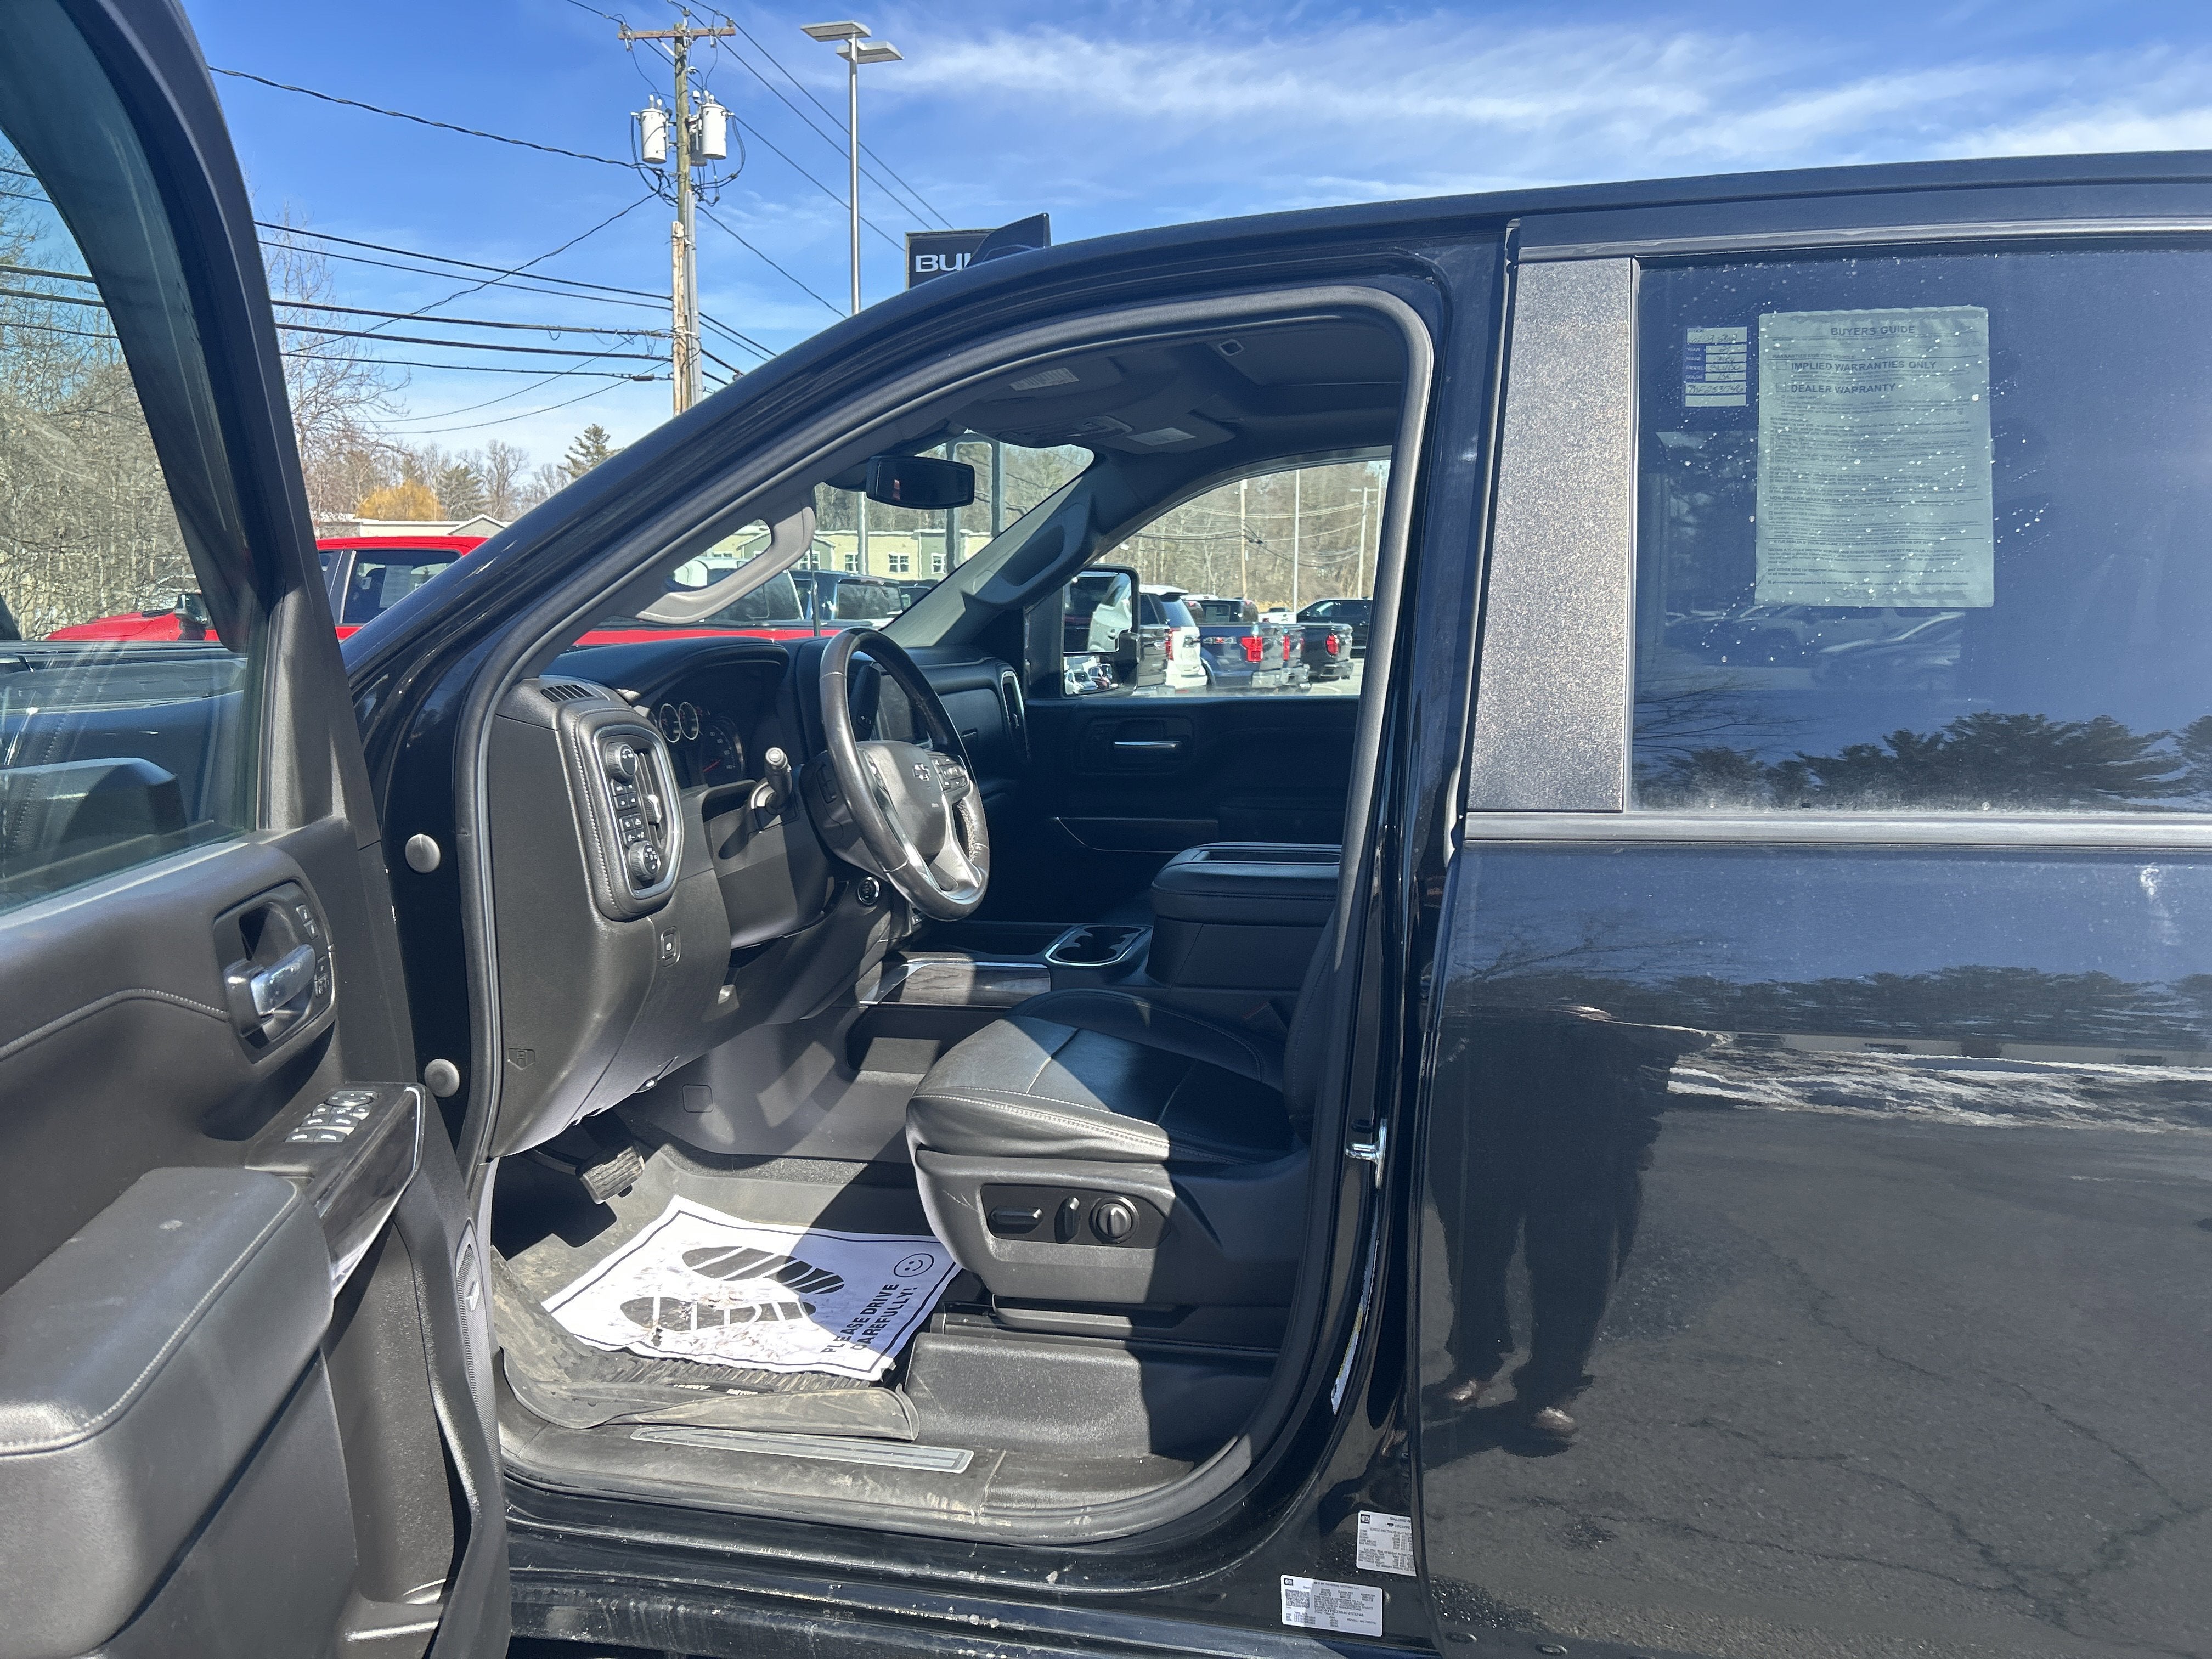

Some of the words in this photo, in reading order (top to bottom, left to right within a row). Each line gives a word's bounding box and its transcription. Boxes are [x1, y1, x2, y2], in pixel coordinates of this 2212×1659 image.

[1831, 327, 1875, 336] BUYERS
[1880, 325, 1915, 335] GUIDE
[1791, 362, 1832, 370] IMPLIED
[1835, 360, 1905, 371] WARRANTIES
[1909, 360, 1937, 369] ONLY
[1791, 385, 1832, 393] DEALER
[1835, 383, 1895, 394] WARRANTY
[820, 1317, 871, 1353] PLEASE
[860, 1284, 900, 1315] DRIVE
[850, 1287, 919, 1350] CAREFULLY!
